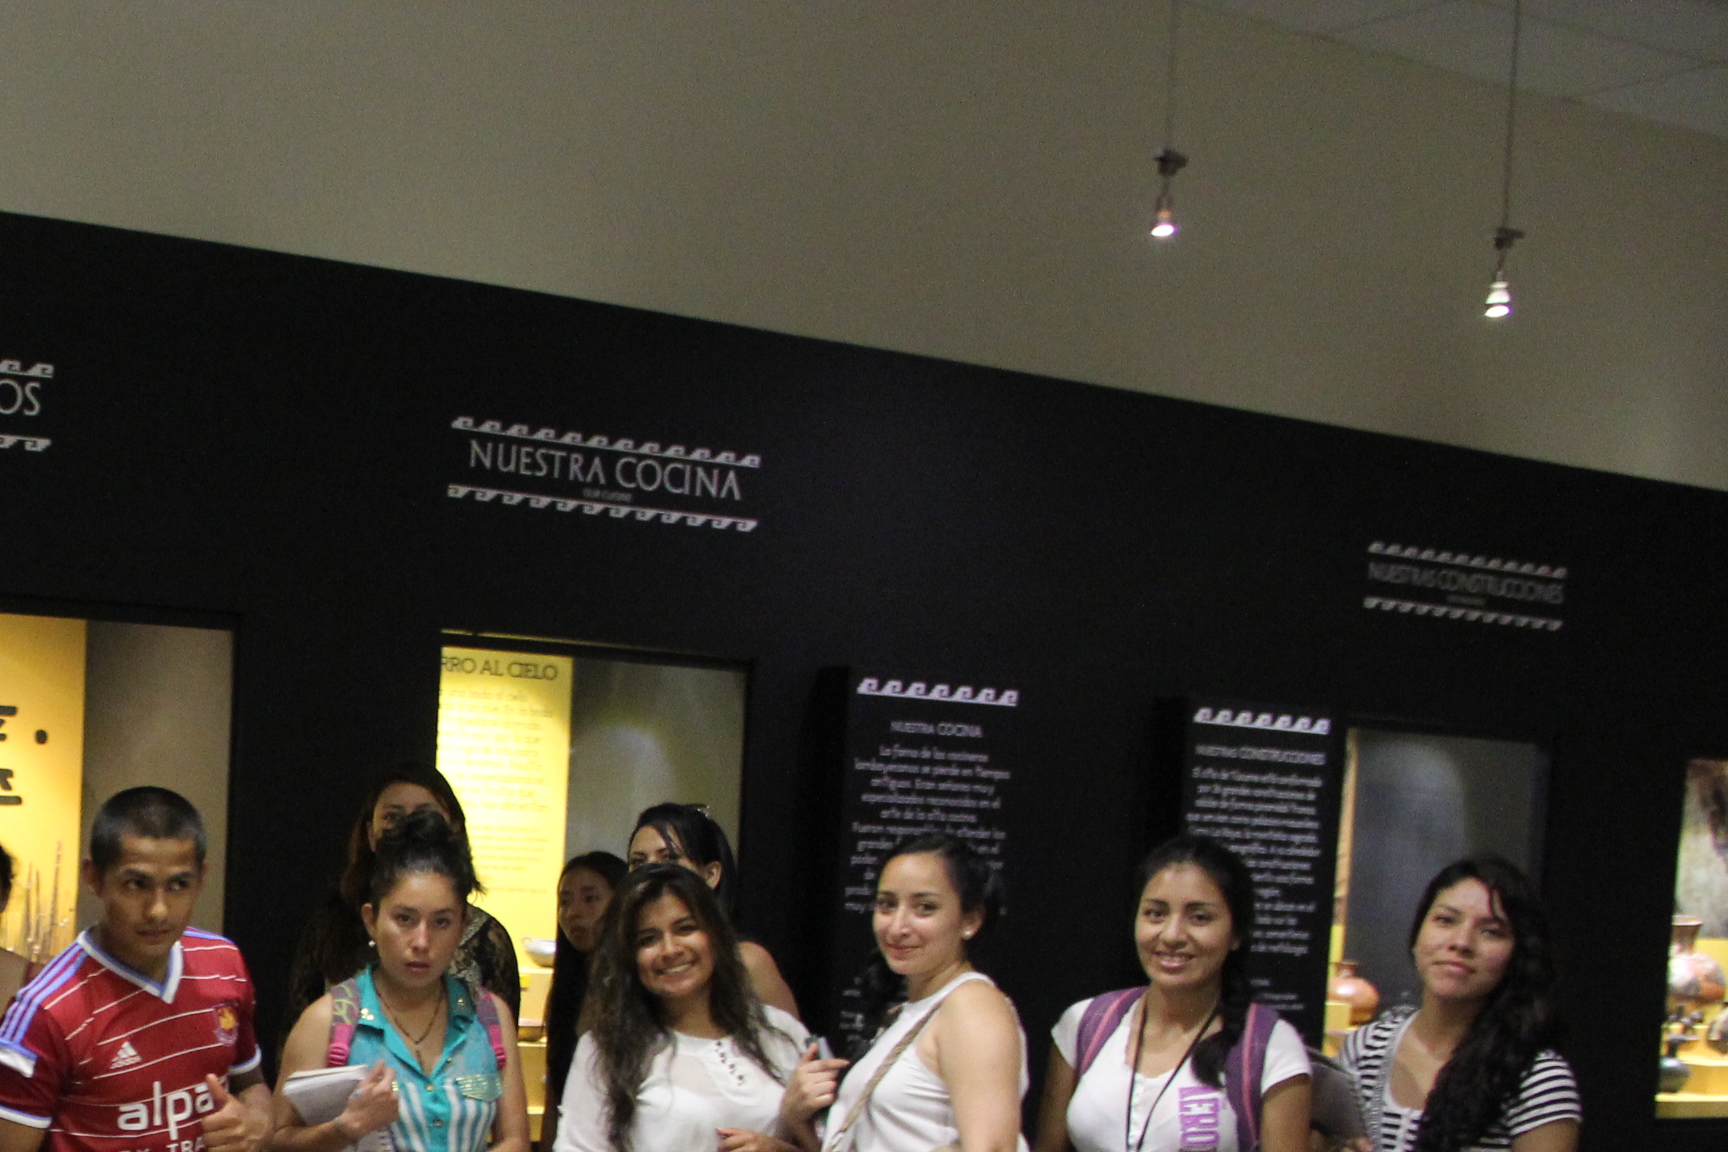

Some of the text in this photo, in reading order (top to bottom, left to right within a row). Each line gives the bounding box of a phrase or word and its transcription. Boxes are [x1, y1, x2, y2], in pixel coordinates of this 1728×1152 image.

[469, 439, 743, 501] NUESTRA COCINA
[479, 660, 504, 677] AL
[507, 662, 559, 681] CIELO
